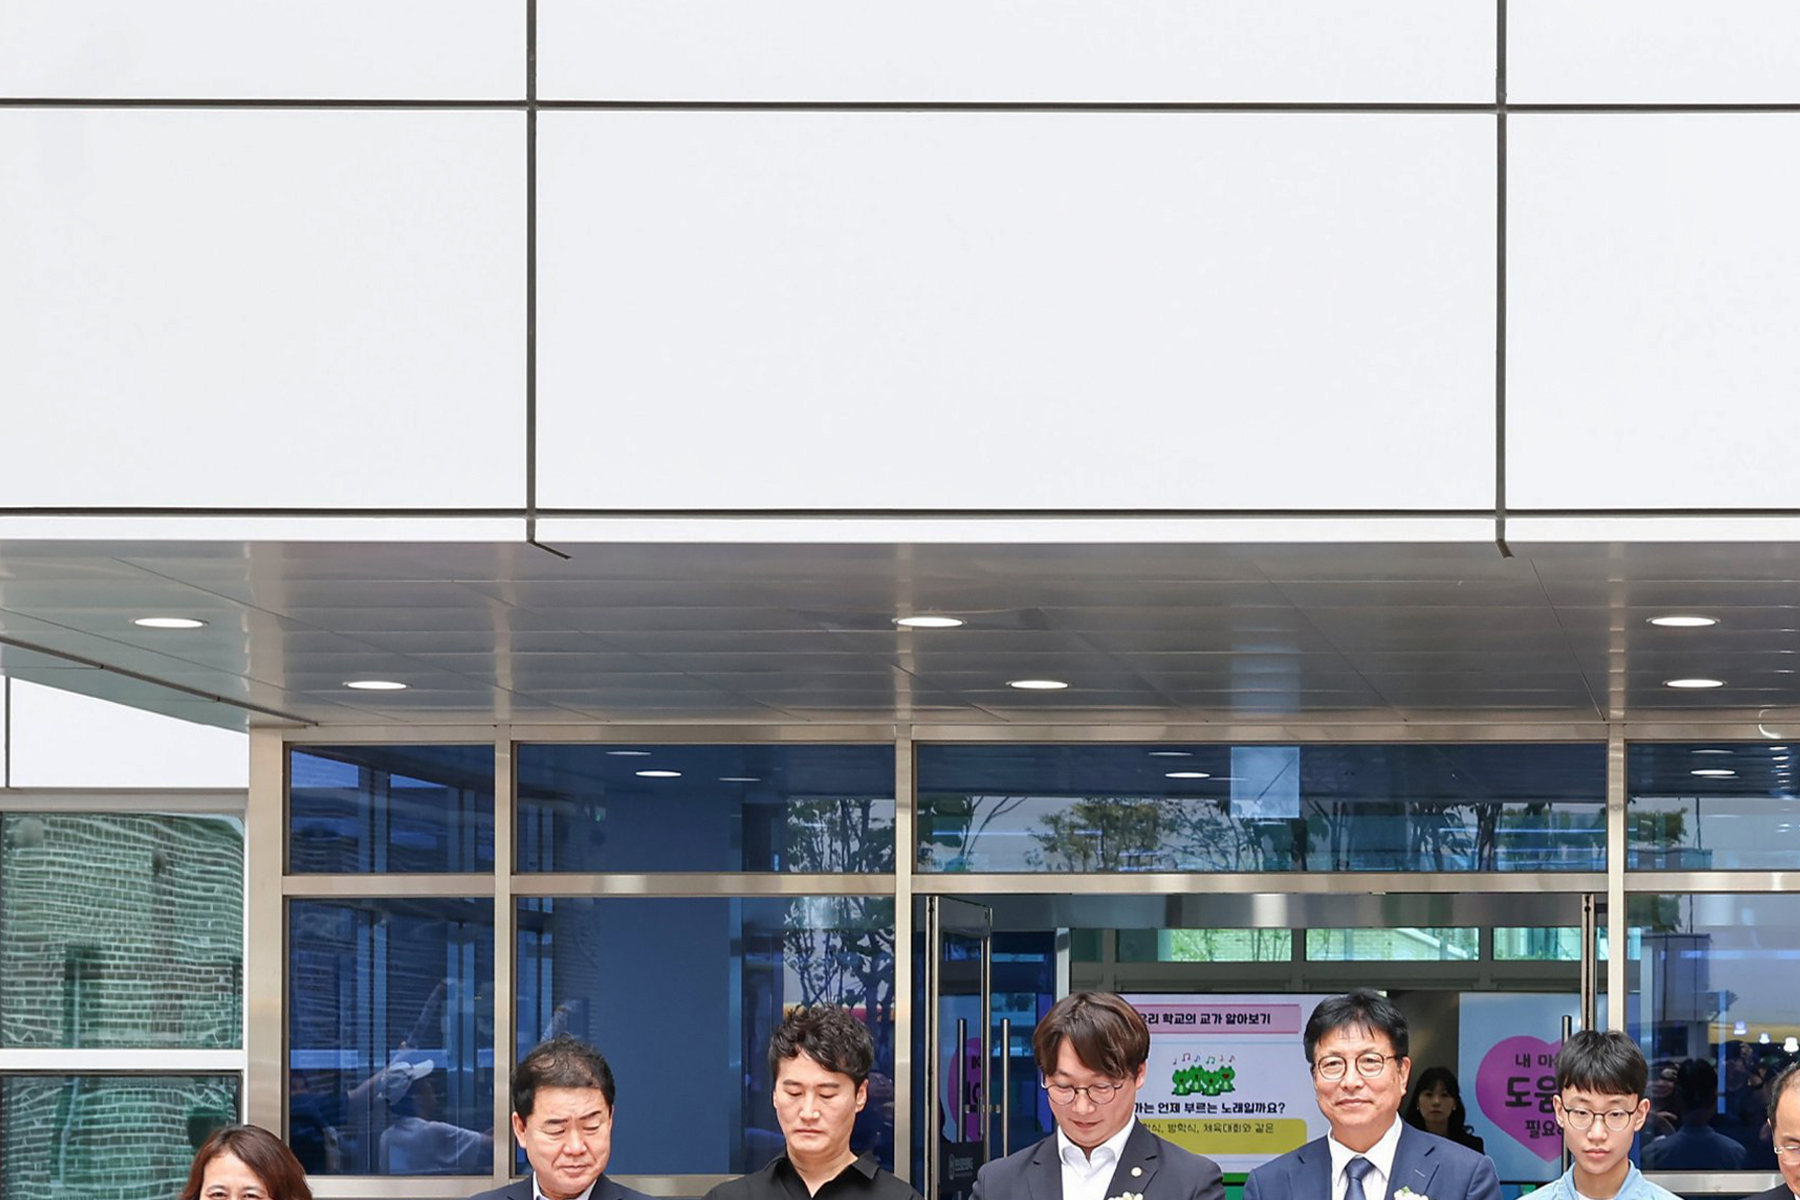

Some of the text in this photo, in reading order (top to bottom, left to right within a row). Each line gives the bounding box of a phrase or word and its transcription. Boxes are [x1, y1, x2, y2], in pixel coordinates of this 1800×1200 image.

[1162, 1013, 1196, 1025] 학교의
[1200, 1013, 1222, 1024] 교가
[1225, 1013, 1271, 1025] 알아보기
[1515, 1053, 1557, 1068] 내 마
[1158, 1102, 1180, 1114] 언제
[1184, 1102, 1217, 1114] 부르는
[1221, 1102, 1286, 1114] 노래일까요?
[1203, 1123, 1252, 1134] 체육대회와
[1255, 1123, 1275, 1134] 같은
